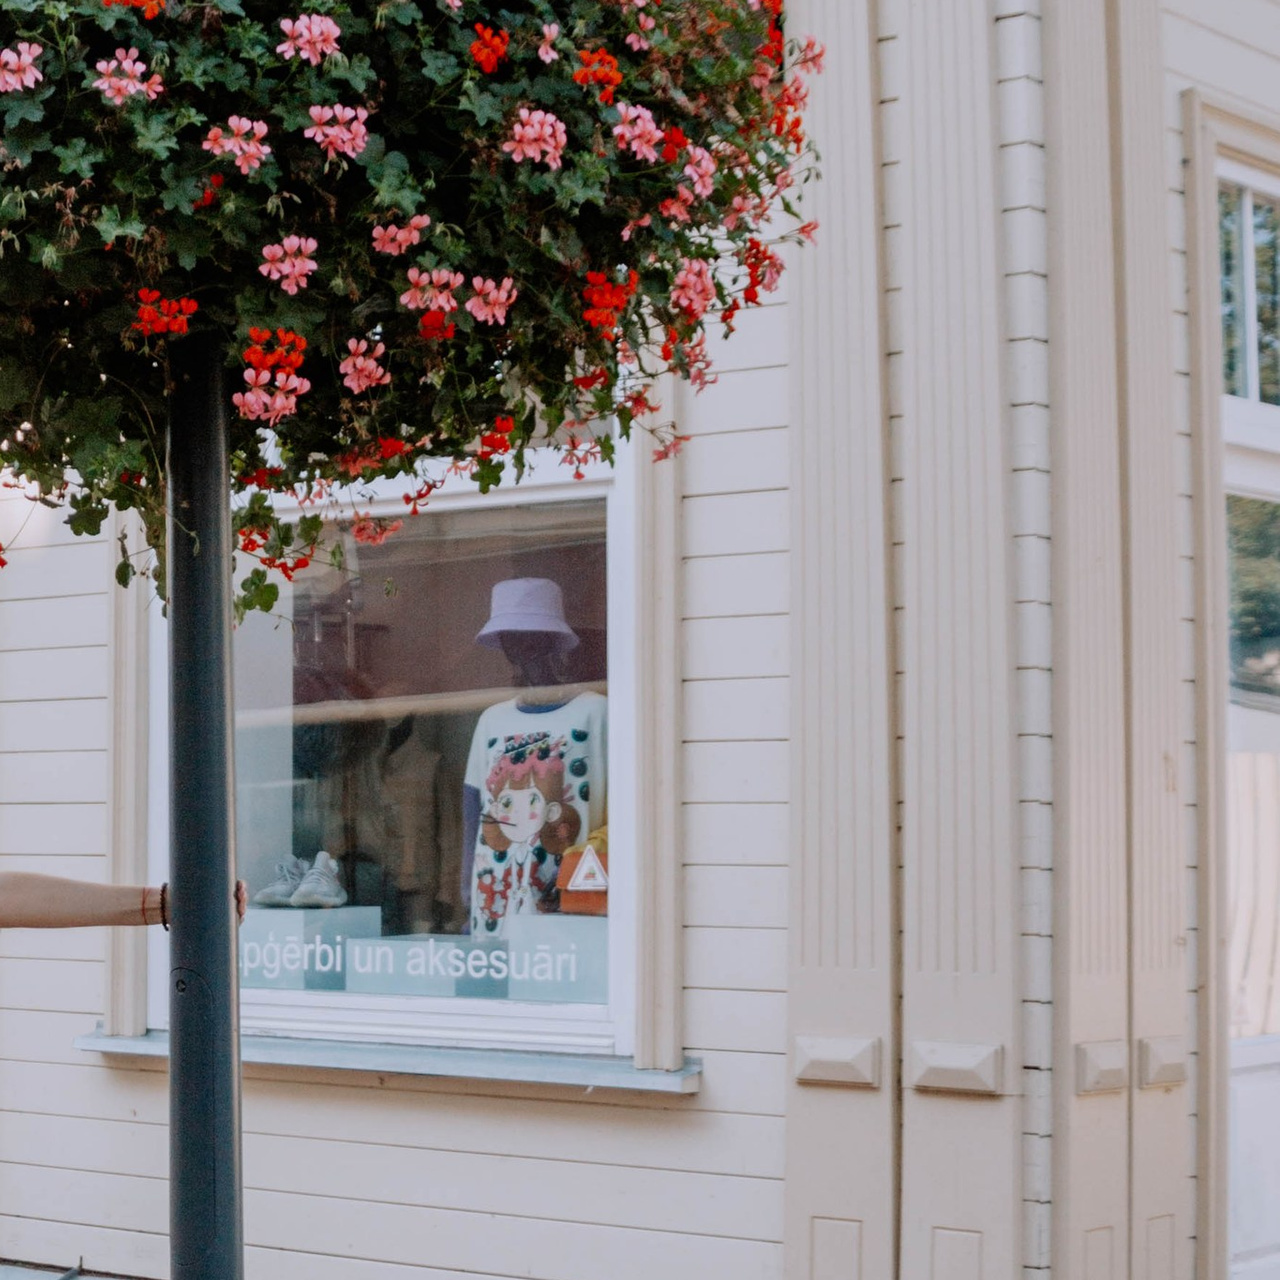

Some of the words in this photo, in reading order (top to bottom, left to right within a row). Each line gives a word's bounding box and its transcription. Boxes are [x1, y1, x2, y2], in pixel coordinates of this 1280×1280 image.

[239, 931, 342, 979] pģērbi
[355, 945, 394, 974] un
[407, 938, 578, 982] aksesuāri
